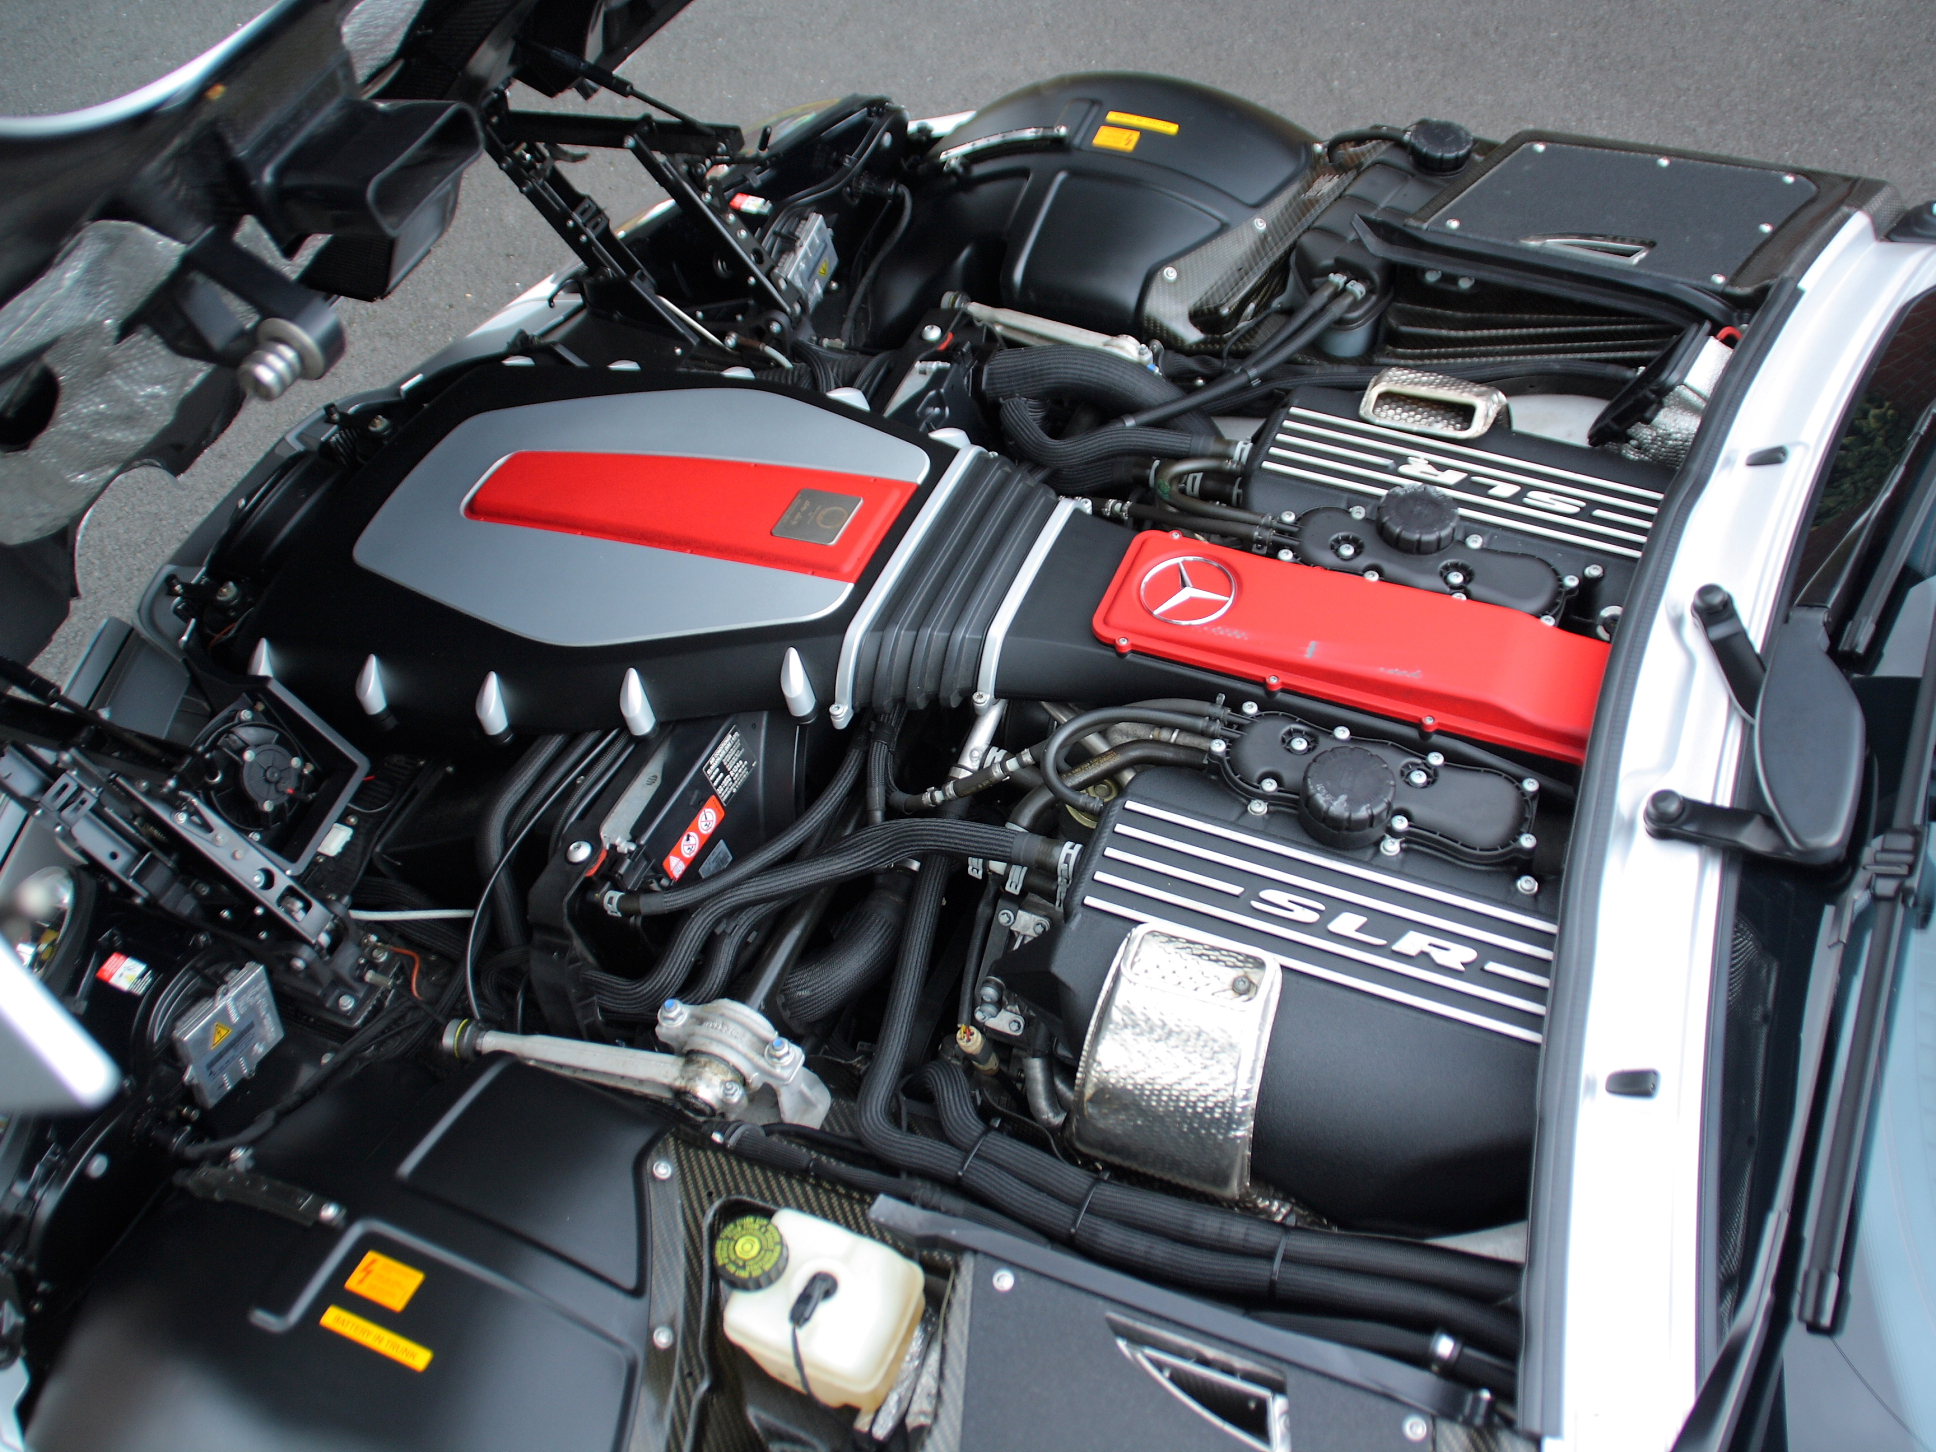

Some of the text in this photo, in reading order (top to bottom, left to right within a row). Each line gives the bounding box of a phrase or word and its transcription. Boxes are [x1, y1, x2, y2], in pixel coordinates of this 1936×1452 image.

[1398, 456, 1586, 515] SLR
[1250, 889, 1478, 972] SLR
[333, 1314, 371, 1338] BATTERY
